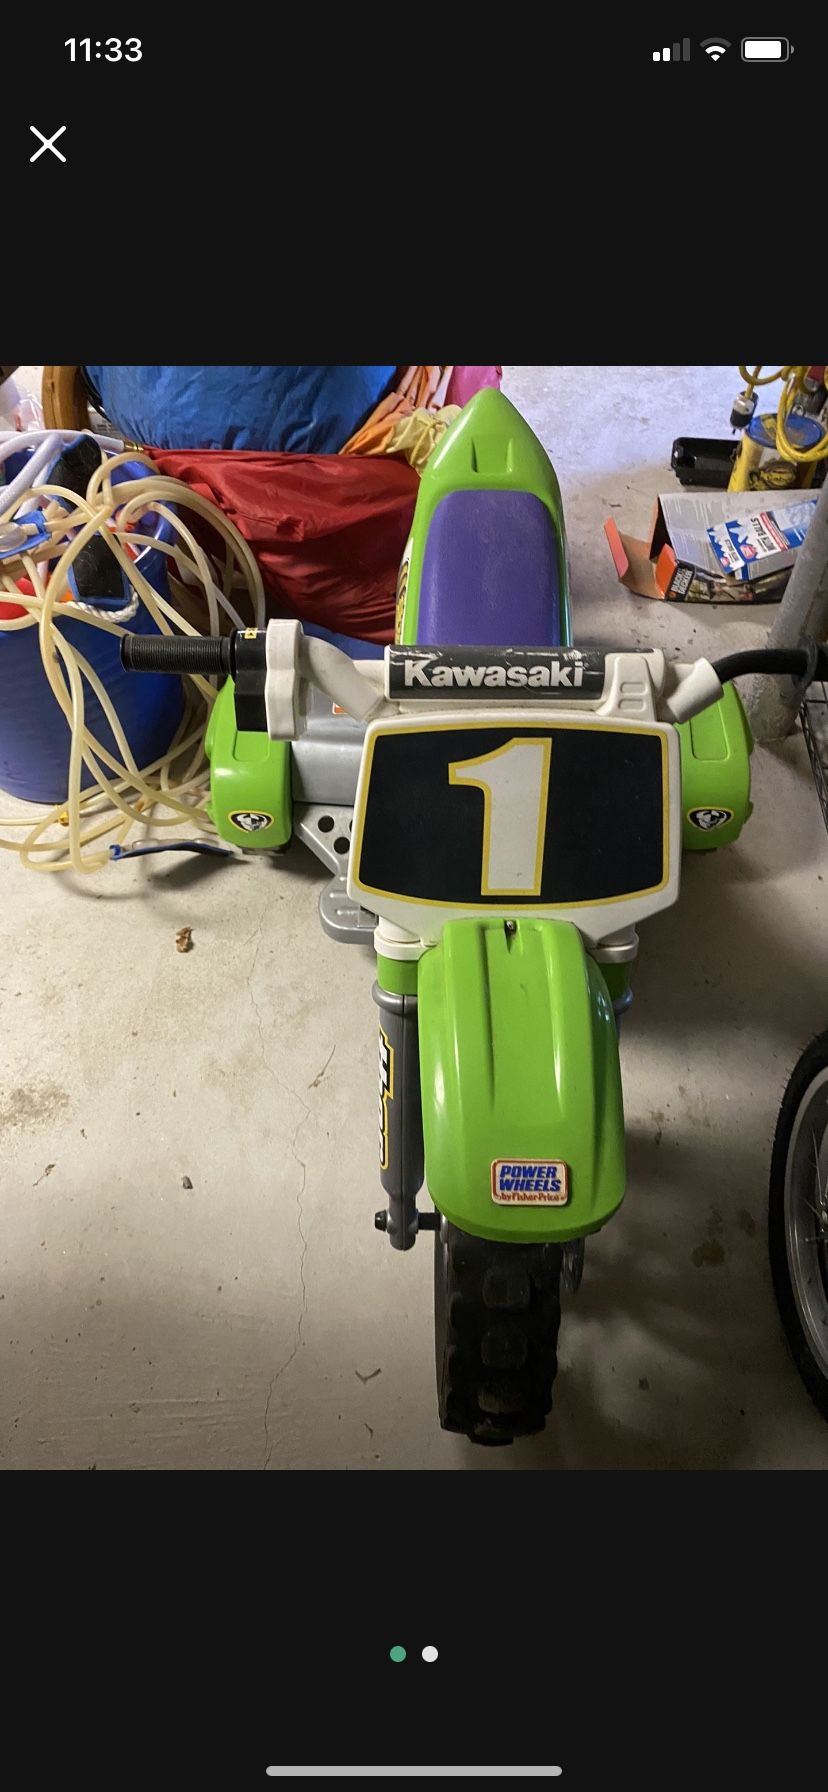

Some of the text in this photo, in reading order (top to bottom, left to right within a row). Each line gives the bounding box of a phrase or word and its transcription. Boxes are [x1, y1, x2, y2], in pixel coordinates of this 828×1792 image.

[404, 659, 584, 688] Kawasaki
[448, 737, 553, 897] 1
[500, 1165, 557, 1178] POWER
[500, 1179, 561, 1192] WHEELS
